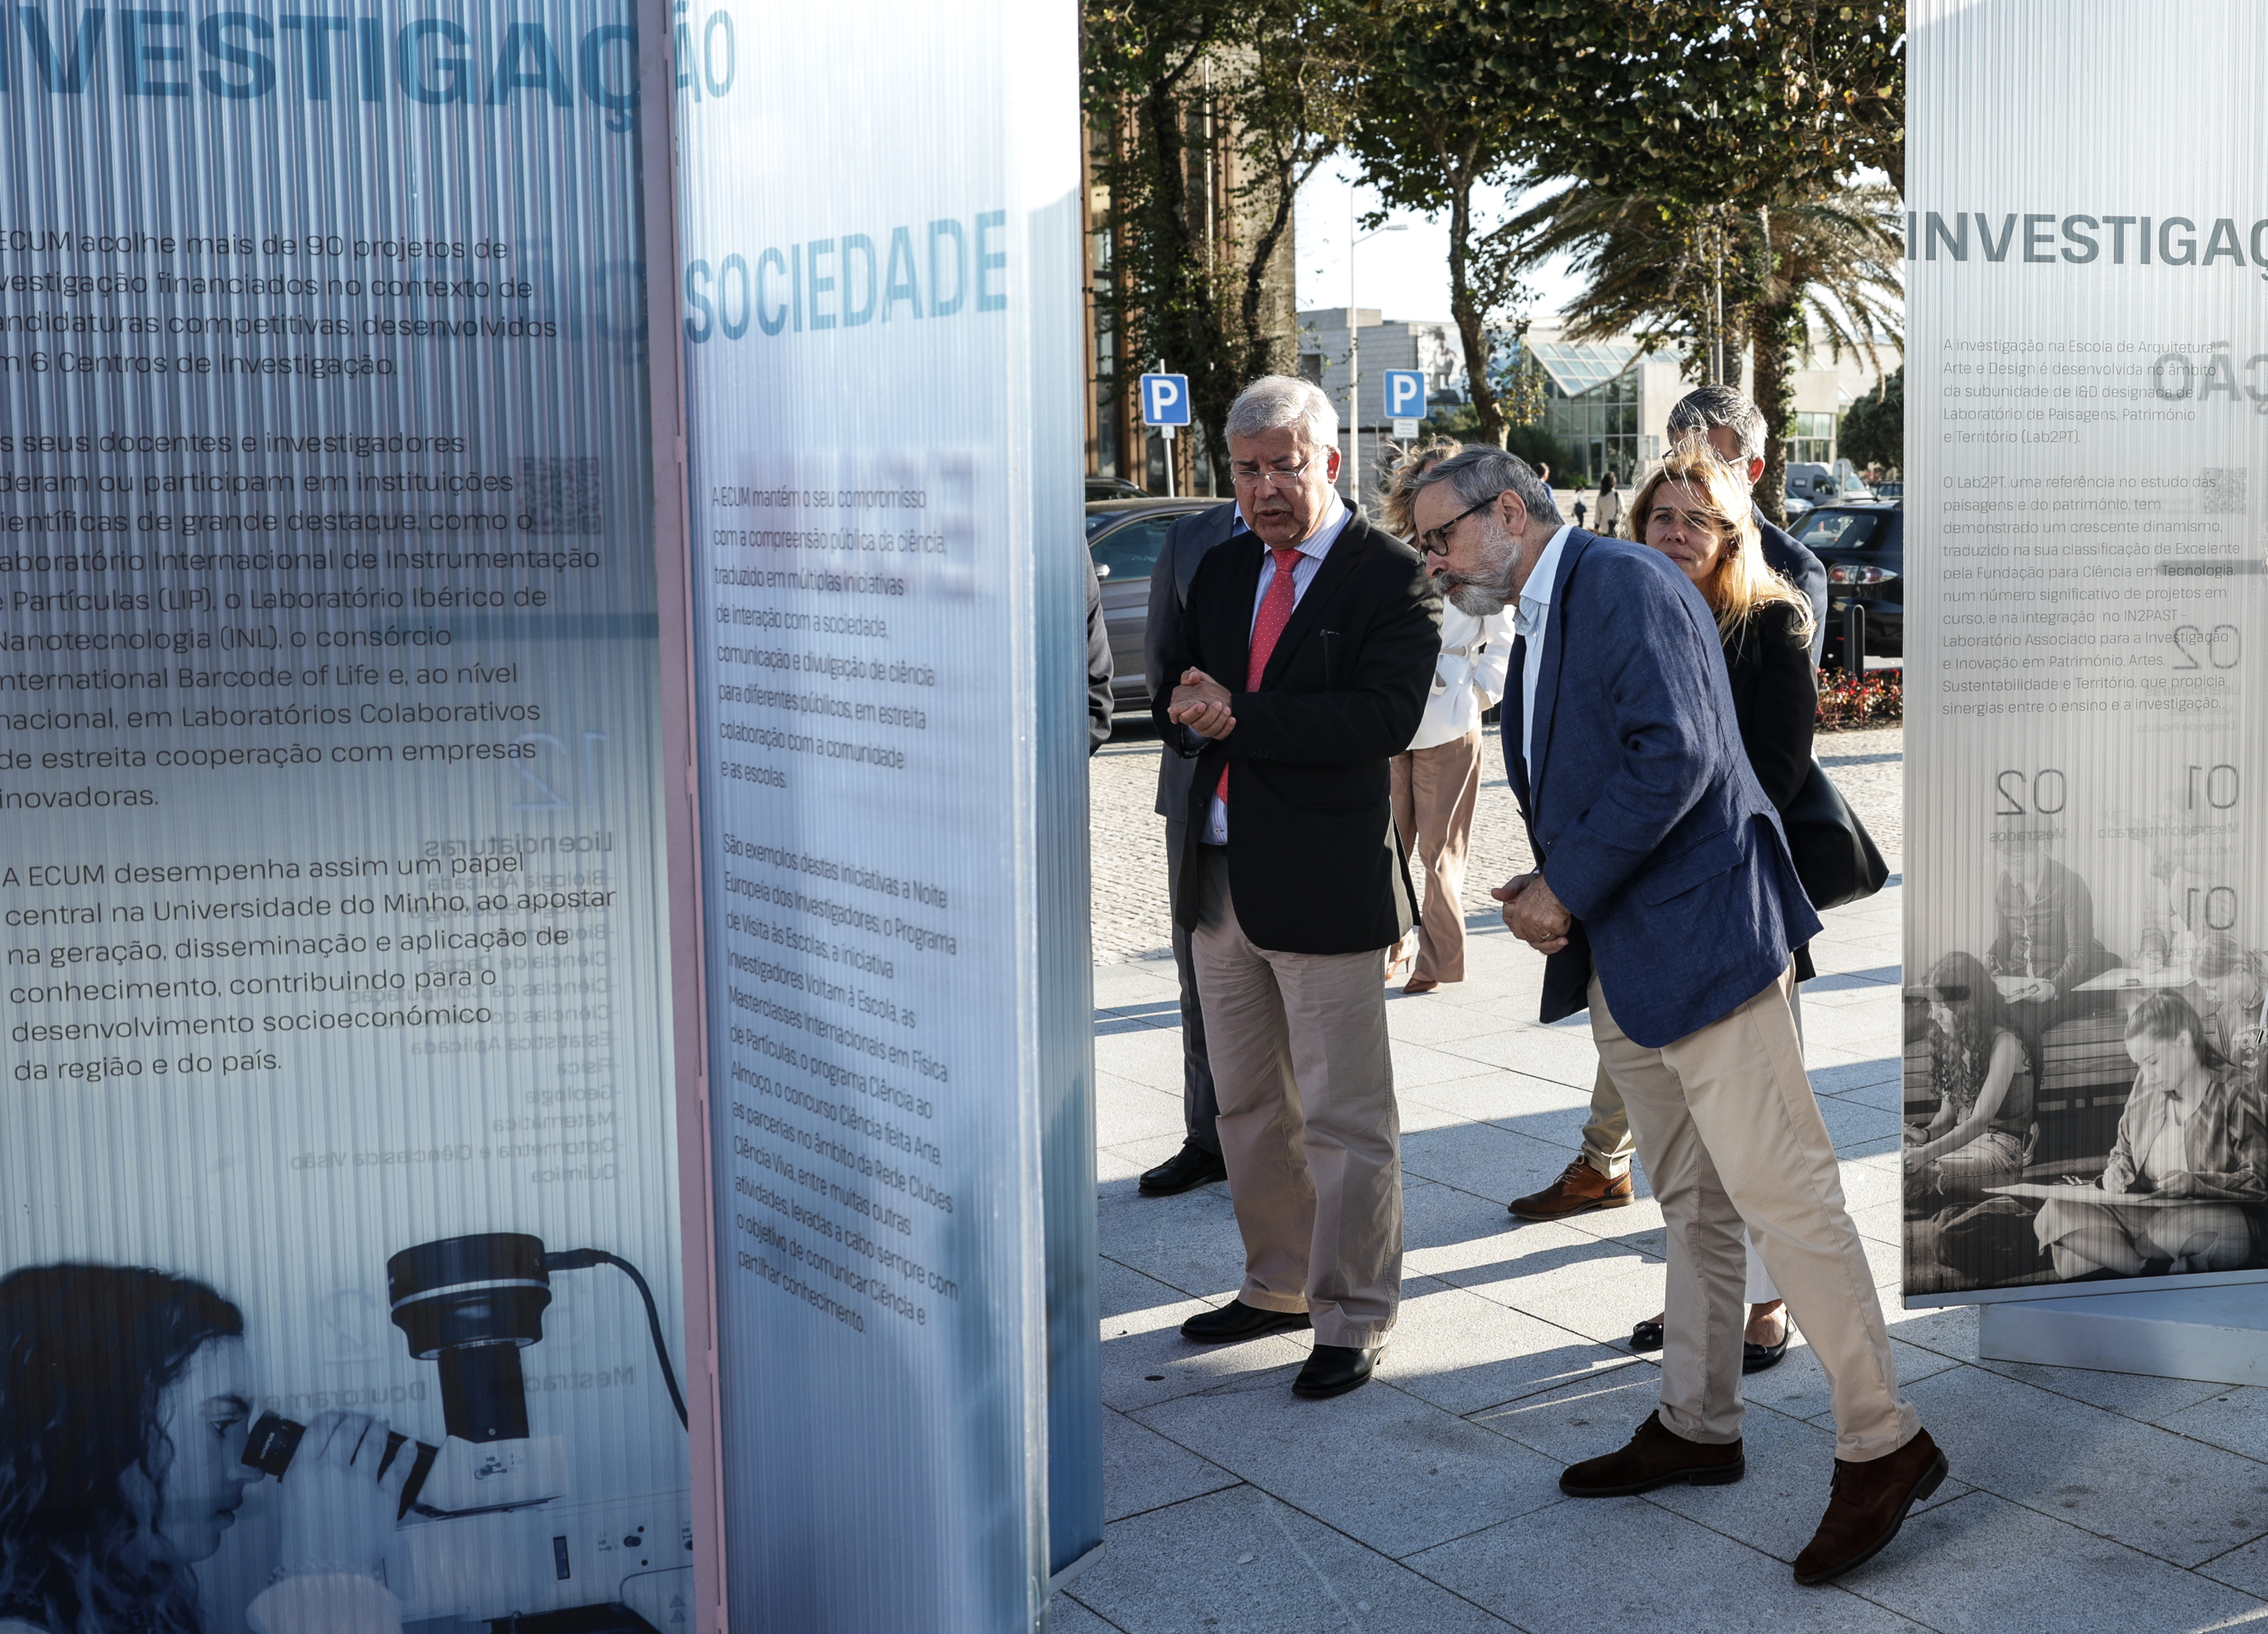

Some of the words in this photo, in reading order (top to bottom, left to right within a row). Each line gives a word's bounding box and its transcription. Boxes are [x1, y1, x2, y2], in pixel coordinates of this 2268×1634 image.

[0, 5, 641, 133] VESTIGAÇ
[0, 230, 70, 253] ECUM
[81, 232, 175, 254] acolhe
[187, 234, 253, 256] mais
[262, 234, 296, 256] de
[305, 235, 343, 257] 90
[354, 237, 465, 262] projetos
[474, 237, 507, 259] de
[156, 271, 318, 296] financiados
[328, 278, 361, 296] no
[371, 278, 489, 299] contexto
[499, 275, 532, 299] de
[685, 209, 1007, 344] SOCIEDADE
[0, 311, 159, 335] ndidaturas
[169, 312, 354, 338] competitivas,
[363, 315, 556, 338] desenvolvidos
[1944, 340, 1953, 351] A
[1957, 340, 2043, 355] investigação
[2049, 342, 2065, 352] na
[2070, 340, 2112, 353] Escola
[2117, 341, 2134, 353] de
[2139, 341, 2215, 355] Arquitetura,
[31, 351, 48, 374] 6
[59, 351, 167, 374] Centros
[176, 352, 211, 375] de
[222, 354, 397, 379] Investigação.
[1151, 380, 1179, 420] P
[1393, 374, 1418, 414] P
[1944, 386, 1961, 398] da
[1966, 386, 2048, 398] subunidade
[2053, 386, 2071, 398] de
[2075, 386, 2098, 398] I&D
[2102, 386, 2172, 402] designada
[2177, 387, 2193, 399] de
[23, 434, 89, 453] seus
[99, 431, 231, 453] docentes
[242, 436, 256, 453] e
[267, 432, 465, 456] investigadores
[1944, 432, 1952, 442] e
[1957, 429, 2017, 443] Território
[2022, 429, 2081, 444] (Lab2PT).
[0, 470, 88, 494] deram
[99, 474, 133, 492] ou
[144, 471, 294, 497] participam
[304, 474, 349, 492] em
[358, 470, 513, 495] instituições
[1943, 476, 1953, 488] O
[1957, 476, 2006, 488] Lab2PT,
[2010, 478, 2041, 488] uma
[2046, 475, 2115, 488] referência
[2119, 479, 2136, 488] no
[2141, 476, 2189, 488] estudo
[2192, 476, 2216, 488] das
[712, 487, 720, 507] A
[722, 487, 749, 507] ECUM
[753, 485, 799, 507] mantém
[804, 491, 809, 507] o
[813, 491, 832, 507] seu
[838, 485, 925, 512] compromisso
[0, 549, 144, 573] aboratório
[154, 550, 333, 571] Internacional
[343, 550, 377, 570] de
[386, 547, 600, 574] Instrumentação
[1943, 544, 2009, 557] traduzido
[2013, 546, 2030, 556] na
[2034, 546, 2058, 557] sua
[2062, 542, 2150, 557] classificação
[2155, 543, 2171, 555] de
[2176, 542, 2240, 555] Excelente
[1943, 567, 1972, 581] pela
[1977, 567, 2044, 580] Fundação
[2049, 568, 2078, 580] para
[2083, 566, 2132, 578] Ciência
[2136, 567, 2158, 577] em
[2162, 564, 2235, 578] Tecnologia,
[14, 588, 149, 612] Partículas
[159, 588, 217, 613] (LIP),
[226, 591, 241, 609] o
[251, 587, 403, 610] Laboratório
[413, 586, 504, 608] Ibérico
[513, 587, 547, 607] de
[221, 626, 280, 652] (INL),
[290, 631, 305, 647] o
[316, 625, 451, 647] consórcio
[1943, 679, 2059, 693] Sustentabilidade
[2063, 680, 2071, 689] e
[2075, 676, 2136, 690] Território,
[2141, 678, 2167, 690] que
[2171, 676, 2225, 690] propicia
[127, 710, 172, 728] em
[182, 704, 351, 728] Laboratórios
[361, 702, 541, 724] Colaborativos
[720, 721, 785, 751] colaboração
[788, 733, 813, 754] com
[817, 739, 823, 755] a
[827, 741, 903, 769] comunidade
[721, 761, 727, 777] e
[730, 763, 742, 780] as
[745, 765, 787, 788] escolas.
[3, 867, 20, 888] A
[29, 865, 105, 886] ECUM
[115, 860, 300, 888] desempenha
[309, 857, 388, 878] assim
[398, 857, 442, 875] um
[451, 852, 525, 879] papel
[724, 833, 742, 855] São
[745, 842, 798, 871] exemplos
[801, 854, 838, 880] destas
[841, 862, 899, 897] iniciativas
[903, 881, 909, 899] a
[914, 880, 947, 908] Noite
[6, 904, 101, 927] central
[112, 906, 144, 923] na
[154, 896, 330, 922] Universidade
[341, 895, 374, 917] do
[384, 893, 469, 917] Minho,
[477, 895, 508, 912] ao
[517, 888, 615, 914] apostar
[13, 1014, 253, 1043] desenvolvimento
[264, 1003, 491, 1034] socioeconómico
[729, 984, 802, 1029] Masterclasses
[805, 1012, 885, 1059] Internacionais
[889, 1046, 909, 1068] em
[913, 1050, 947, 1083] Física
[15, 1059, 48, 1082] da
[58, 1056, 142, 1084] região
[153, 1058, 167, 1076] e
[178, 1051, 212, 1074] do
[223, 1049, 280, 1077] país.
[739, 1251, 780, 1285] partilhar
[783, 1274, 865, 1334] conhecimento.
